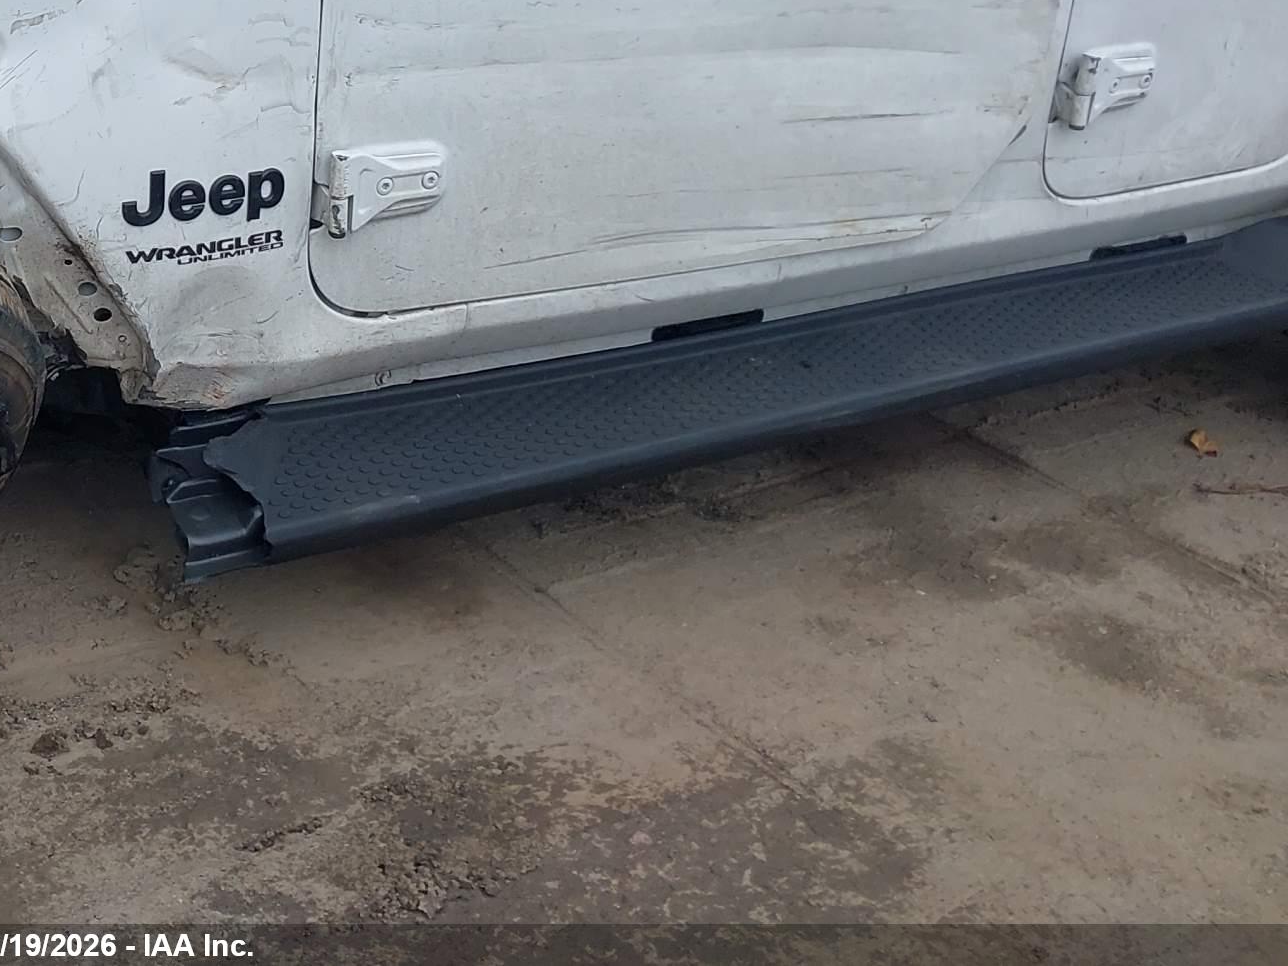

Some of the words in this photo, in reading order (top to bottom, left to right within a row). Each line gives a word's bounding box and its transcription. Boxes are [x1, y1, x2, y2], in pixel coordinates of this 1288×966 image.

[121, 167, 285, 227] Jeep
[125, 229, 283, 264] WRANGLER
[177, 241, 284, 266] UNLIMITED
